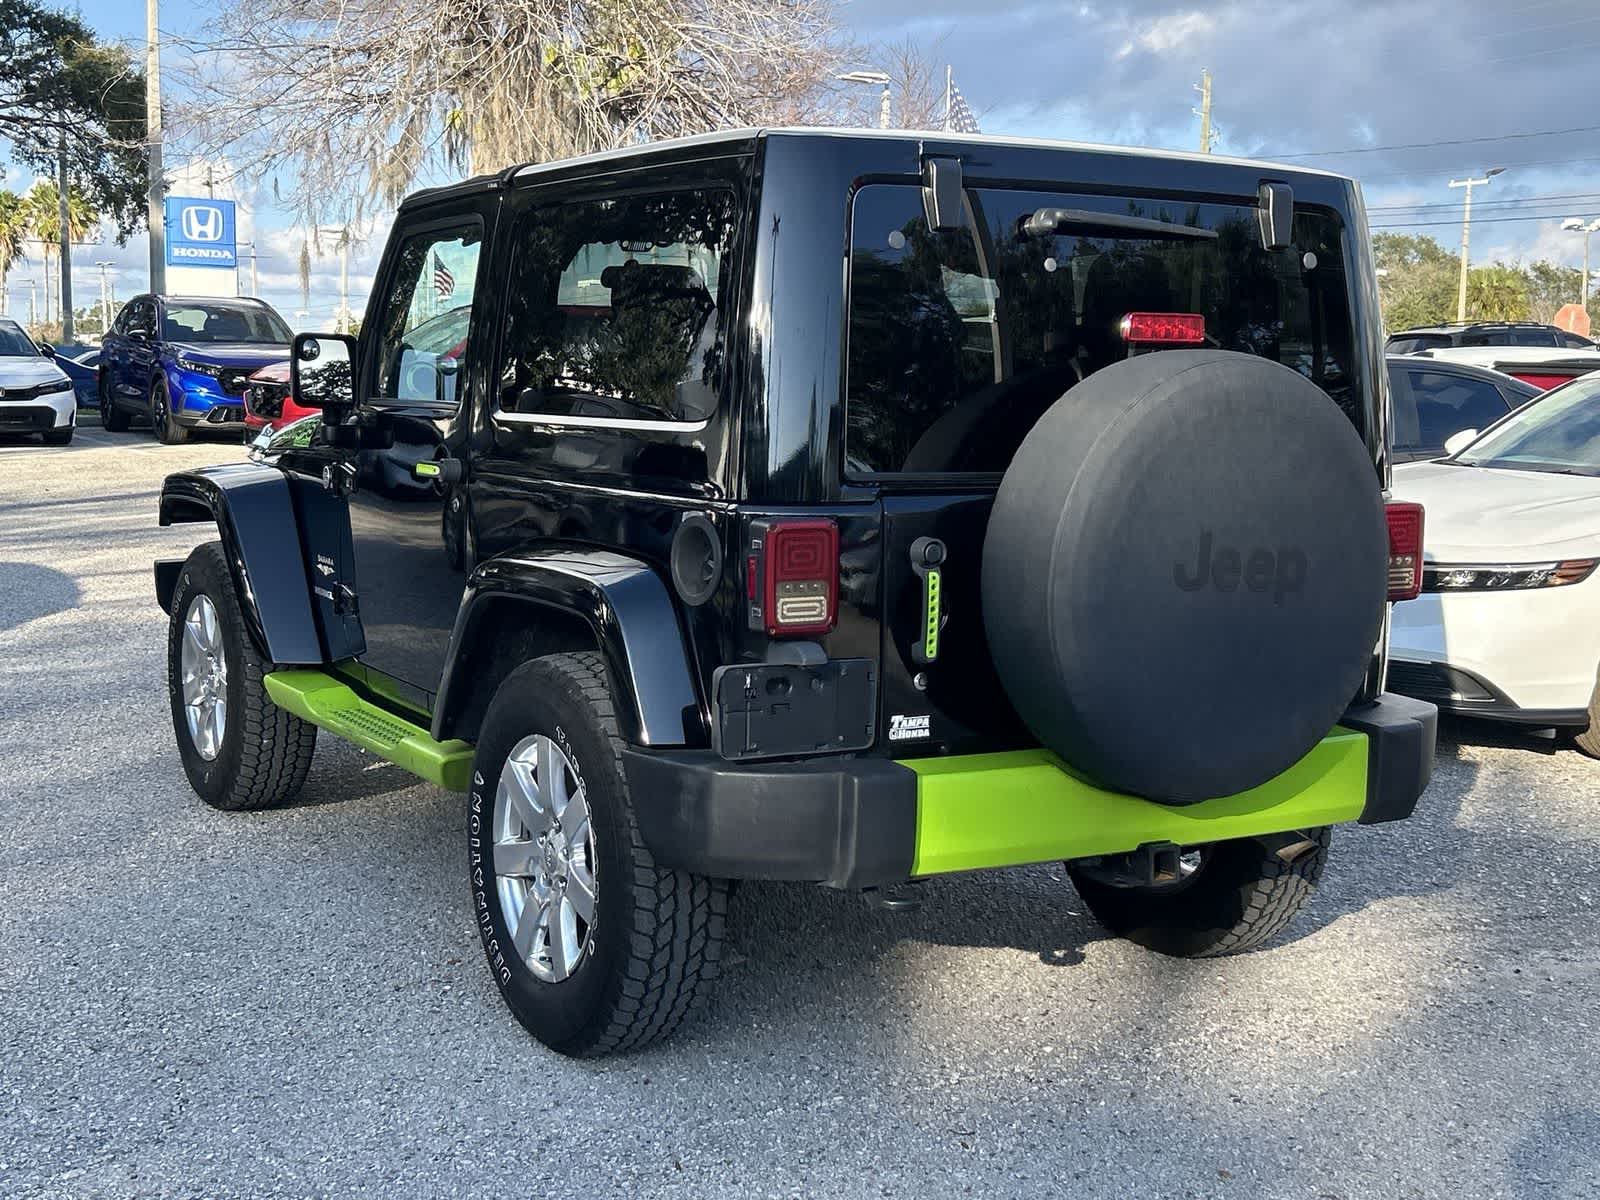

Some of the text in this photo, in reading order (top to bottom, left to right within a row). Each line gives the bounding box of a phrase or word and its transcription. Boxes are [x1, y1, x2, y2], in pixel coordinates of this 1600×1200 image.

[173, 248, 234, 259] HONDA
[1172, 528, 1309, 606] Jeep
[890, 715, 931, 729] TAMPA
[898, 728, 930, 740] HONDA
[471, 792, 512, 986] DESTINATION
